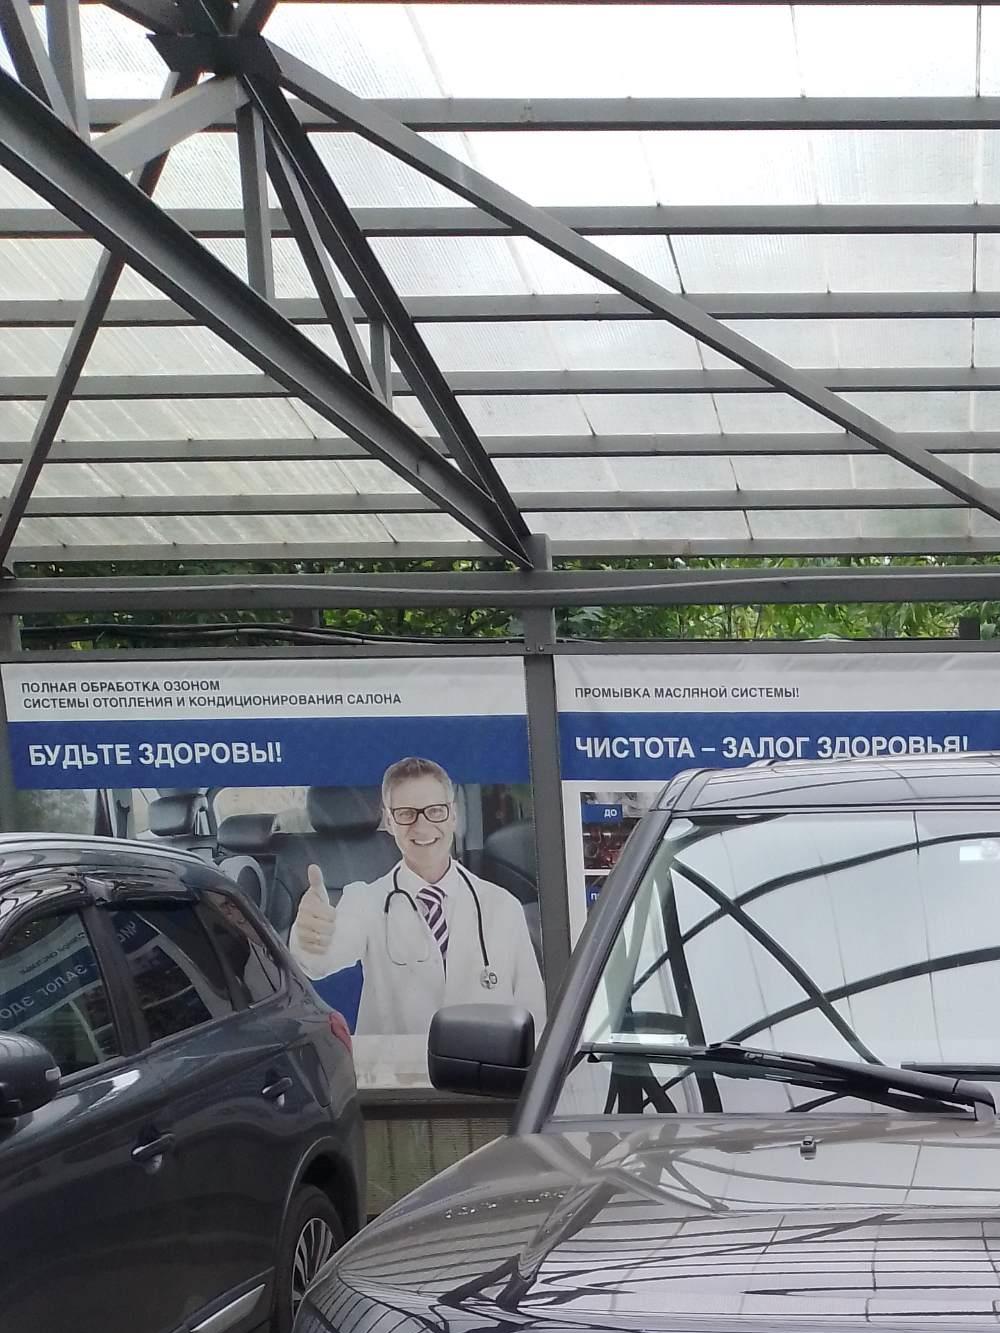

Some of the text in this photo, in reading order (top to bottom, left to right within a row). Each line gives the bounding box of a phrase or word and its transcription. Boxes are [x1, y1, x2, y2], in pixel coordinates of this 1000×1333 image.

[21, 680, 220, 693] ПОЛНАЯ ОБРАБОТКА ОЗОНОМ
[574, 685, 800, 699] ПРОМЫВКА МАСЛЯНОЙ СИСТЕМЫ!
[23, 693, 401, 709] СИСТЕМЫ ОТОПЛЕНИЯ И КОНДИЦИОНИРОВАНИЯ САЛОНА
[575, 737, 695, 758] ЧИСТОТА
[722, 736, 810, 758] ЗАЛОГ
[817, 735, 968, 758] ЗДОРОВЬЯ!
[28, 742, 282, 769] БУДЬТЕ ЗДОРОВЫ!
[604, 804, 618, 818] ДО
